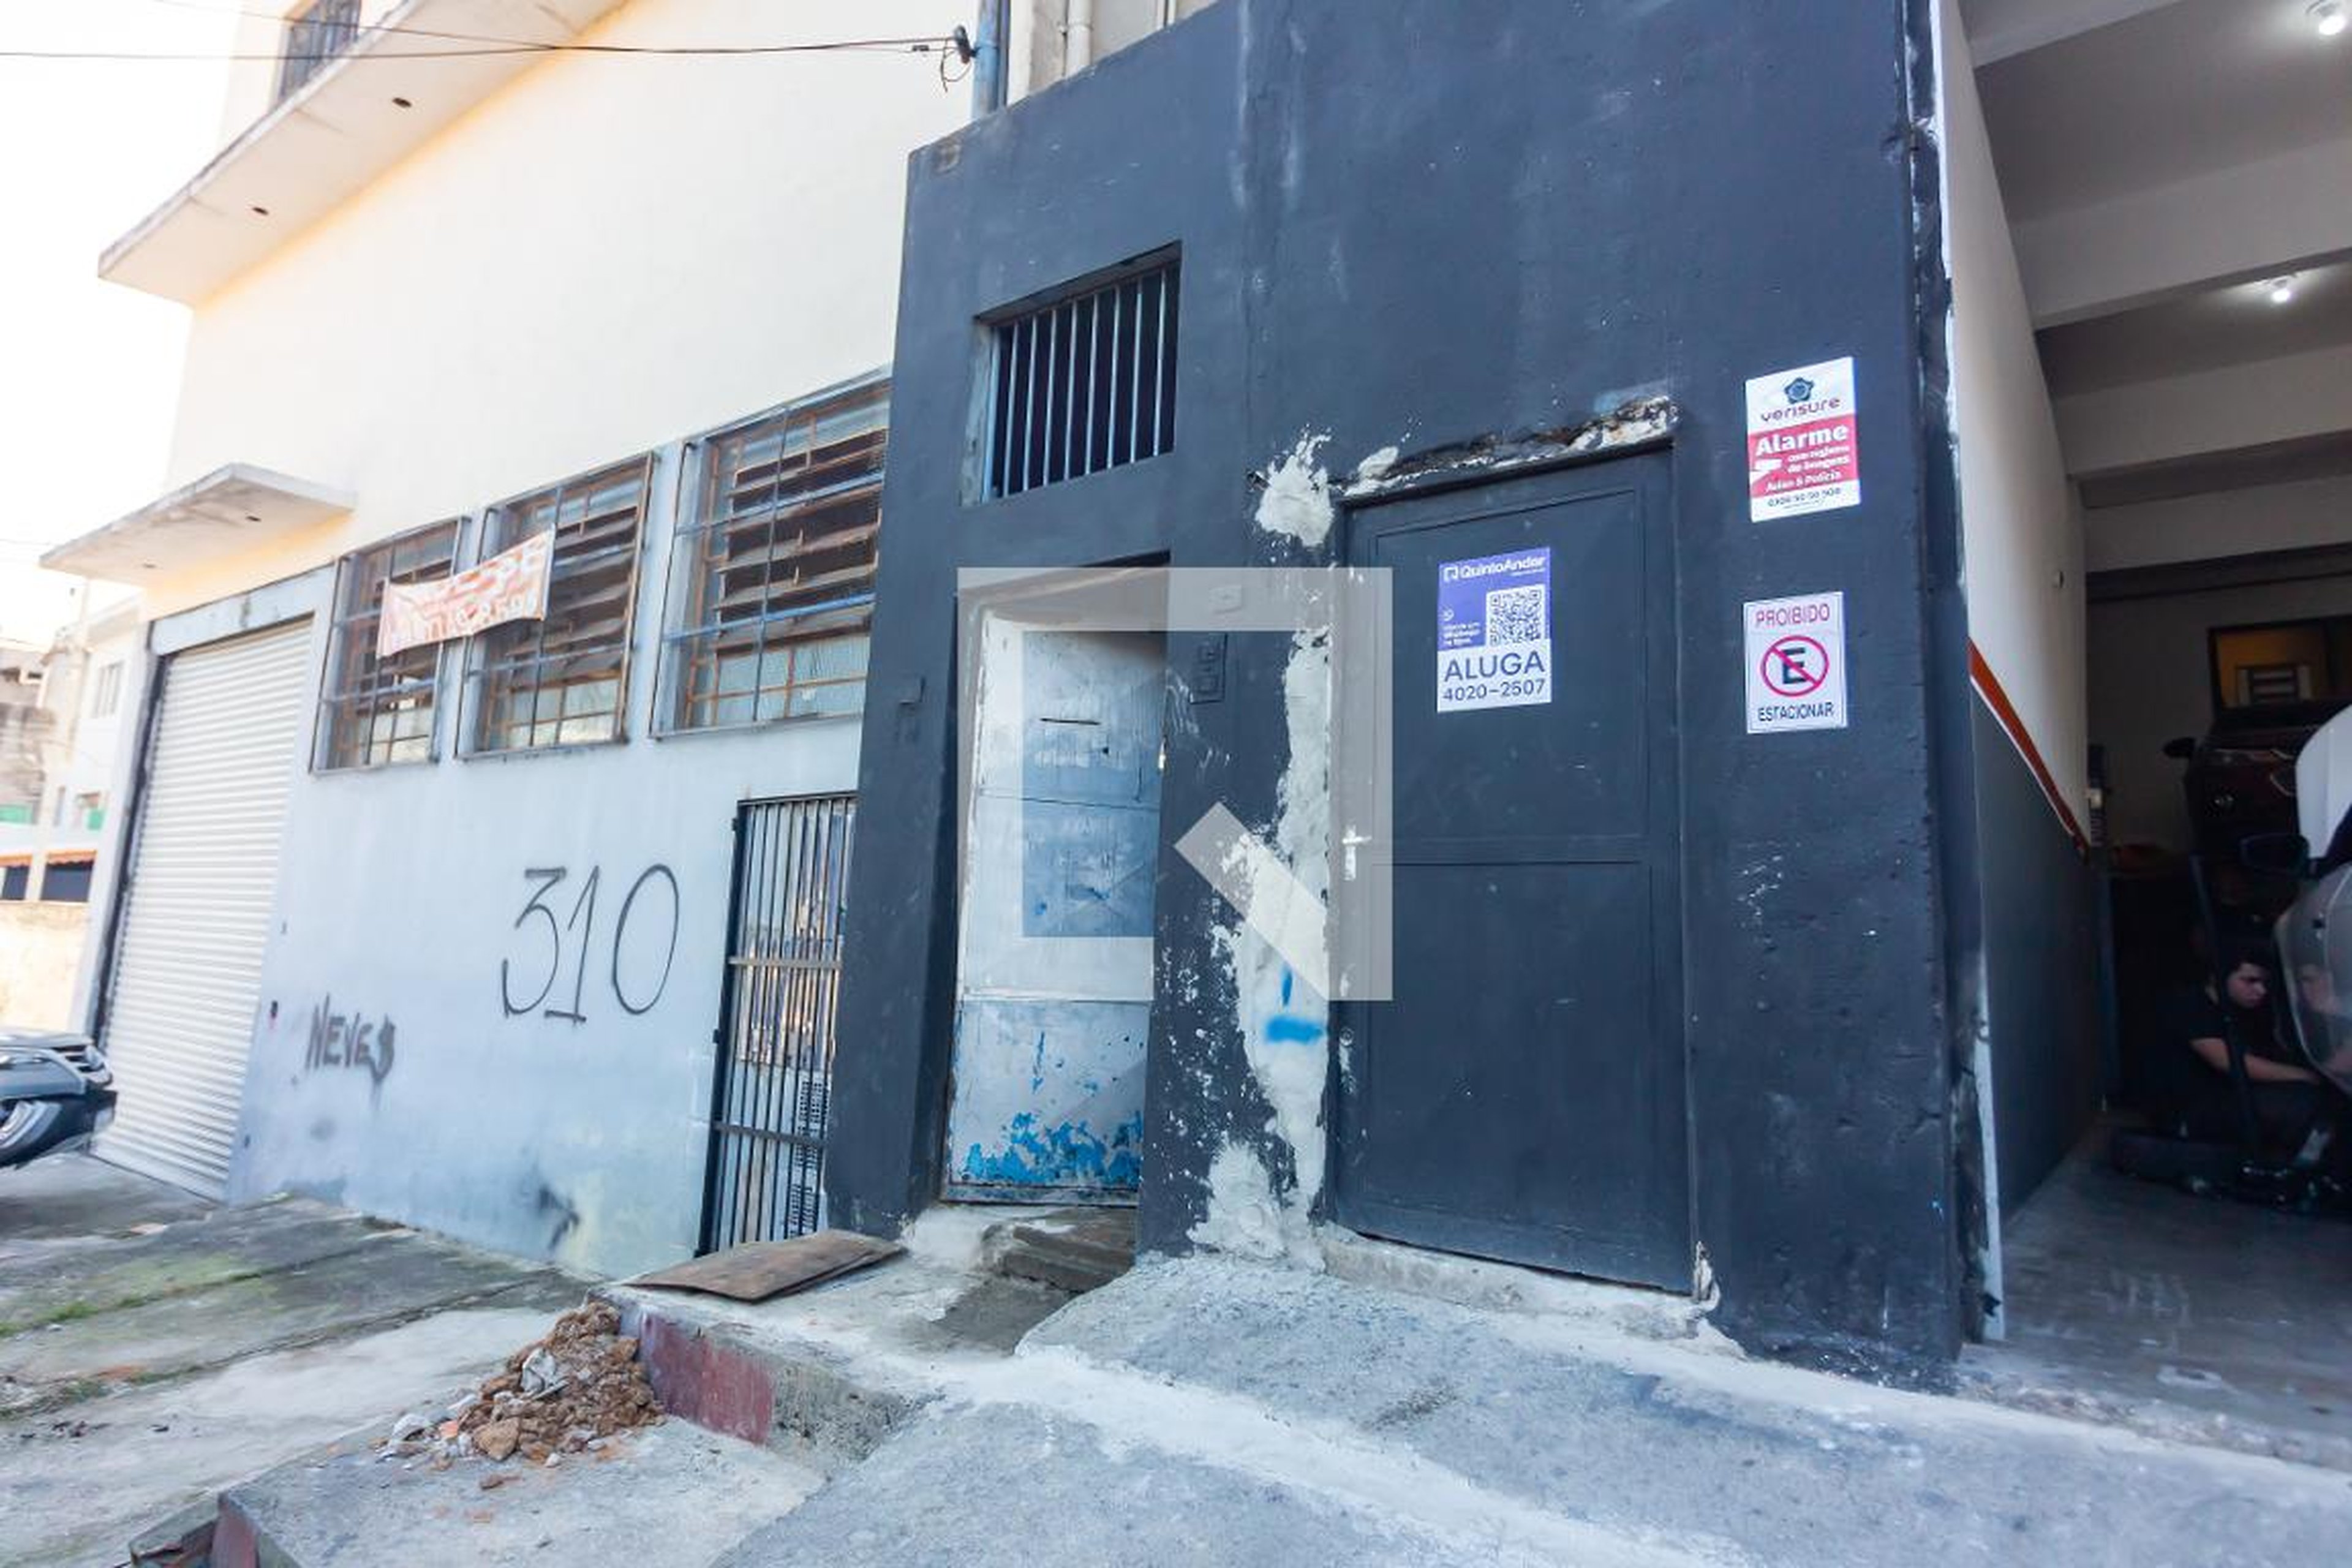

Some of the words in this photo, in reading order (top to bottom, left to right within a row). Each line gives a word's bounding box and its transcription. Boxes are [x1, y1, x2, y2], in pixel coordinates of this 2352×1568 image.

[1762, 398, 1840, 421] verisure
[1755, 425, 1848, 456] Alarme
[1461, 556, 1545, 579] QuintoAndar
[1756, 603, 1830, 627] PROIBIDO
[1444, 650, 1545, 682] ALUGA
[1442, 679, 1545, 701] 4020-2507
[1758, 702, 1834, 722] ESTACIONAR
[500, 864, 679, 1028] 310
